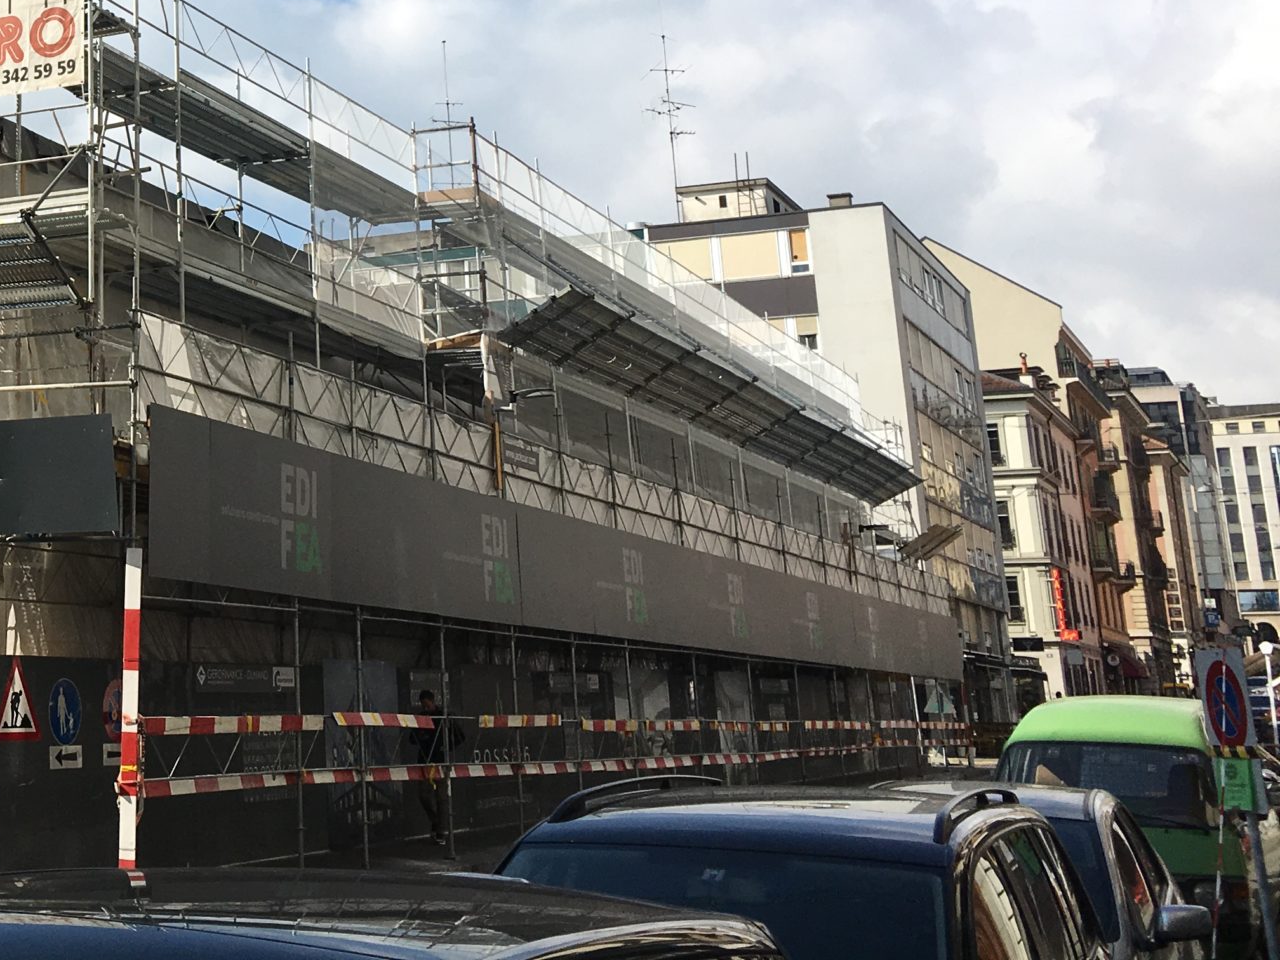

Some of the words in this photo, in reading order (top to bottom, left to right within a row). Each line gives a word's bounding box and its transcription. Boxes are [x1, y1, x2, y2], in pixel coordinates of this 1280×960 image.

[2, 66, 29, 85] 342
[33, 63, 53, 80] 59
[57, 58, 76, 76] 59
[281, 462, 318, 519] EDI
[281, 519, 322, 575] FEA
